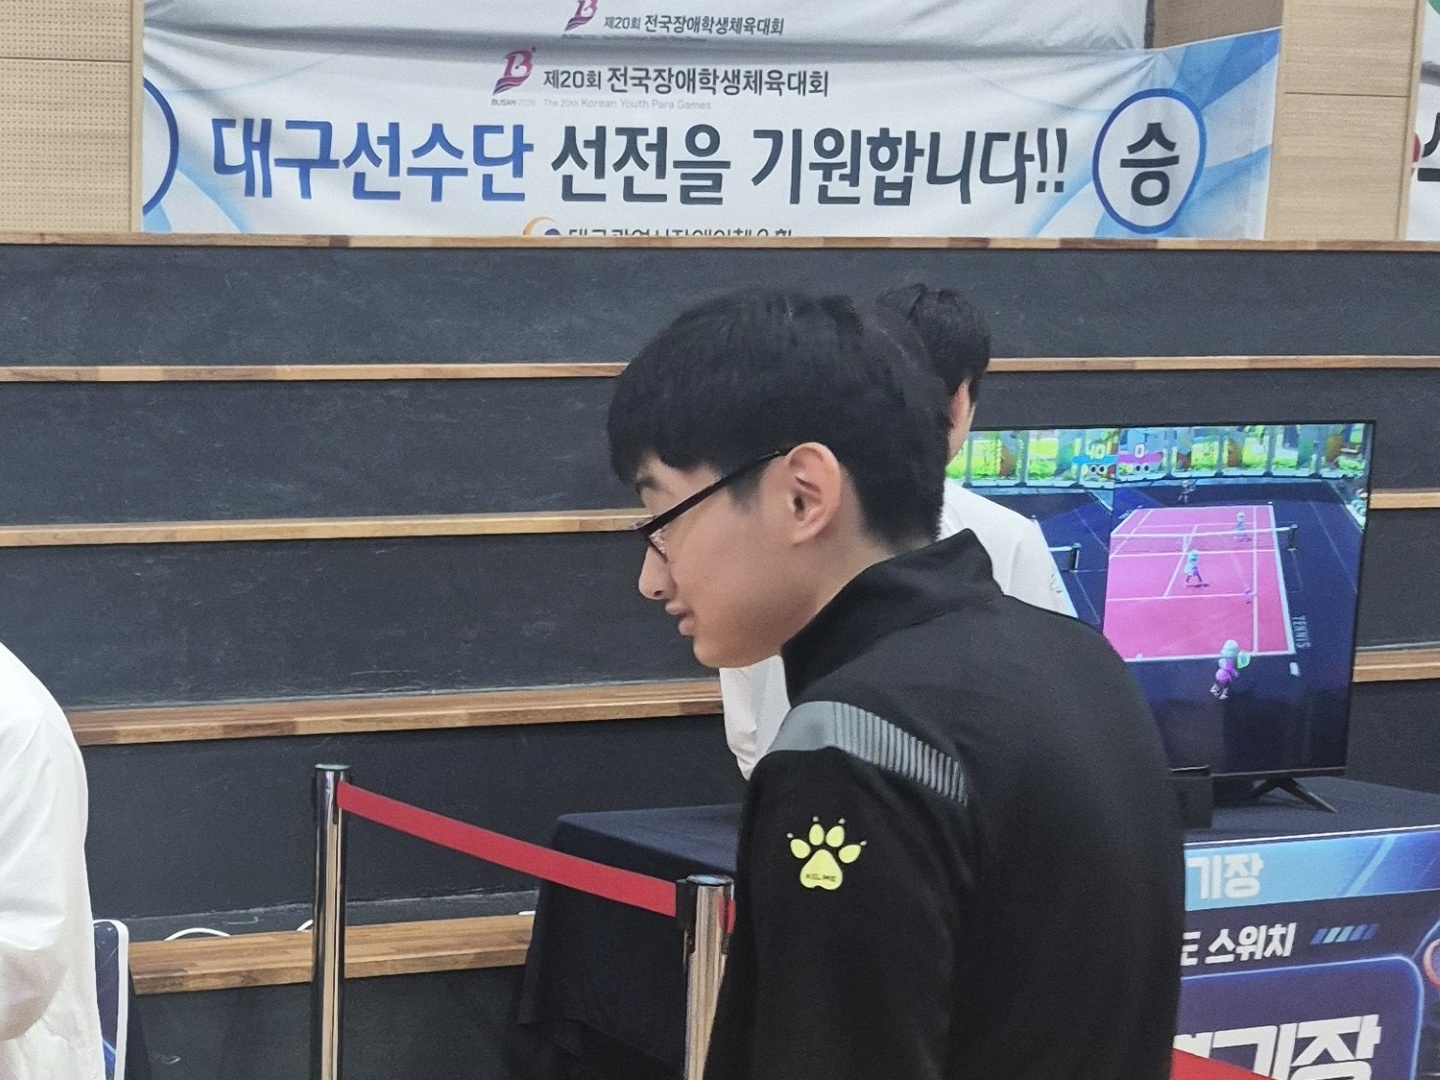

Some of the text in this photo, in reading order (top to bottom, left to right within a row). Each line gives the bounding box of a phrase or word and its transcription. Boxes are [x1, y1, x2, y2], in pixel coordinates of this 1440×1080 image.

[603, 15, 785, 36] 제20회 전국장애학생체육대회
[543, 66, 829, 97] 제20회 전국장애학생체육대회
[581, 98, 617, 108] Korean
[620, 98, 649, 109] Youth
[652, 99, 674, 109] Para
[677, 100, 711, 111] Games
[212, 117, 1068, 206] 대구선수단 선전을 기원합니다!!
[1120, 122, 1180, 206] 승
[1204, 922, 1297, 965] 스위치
